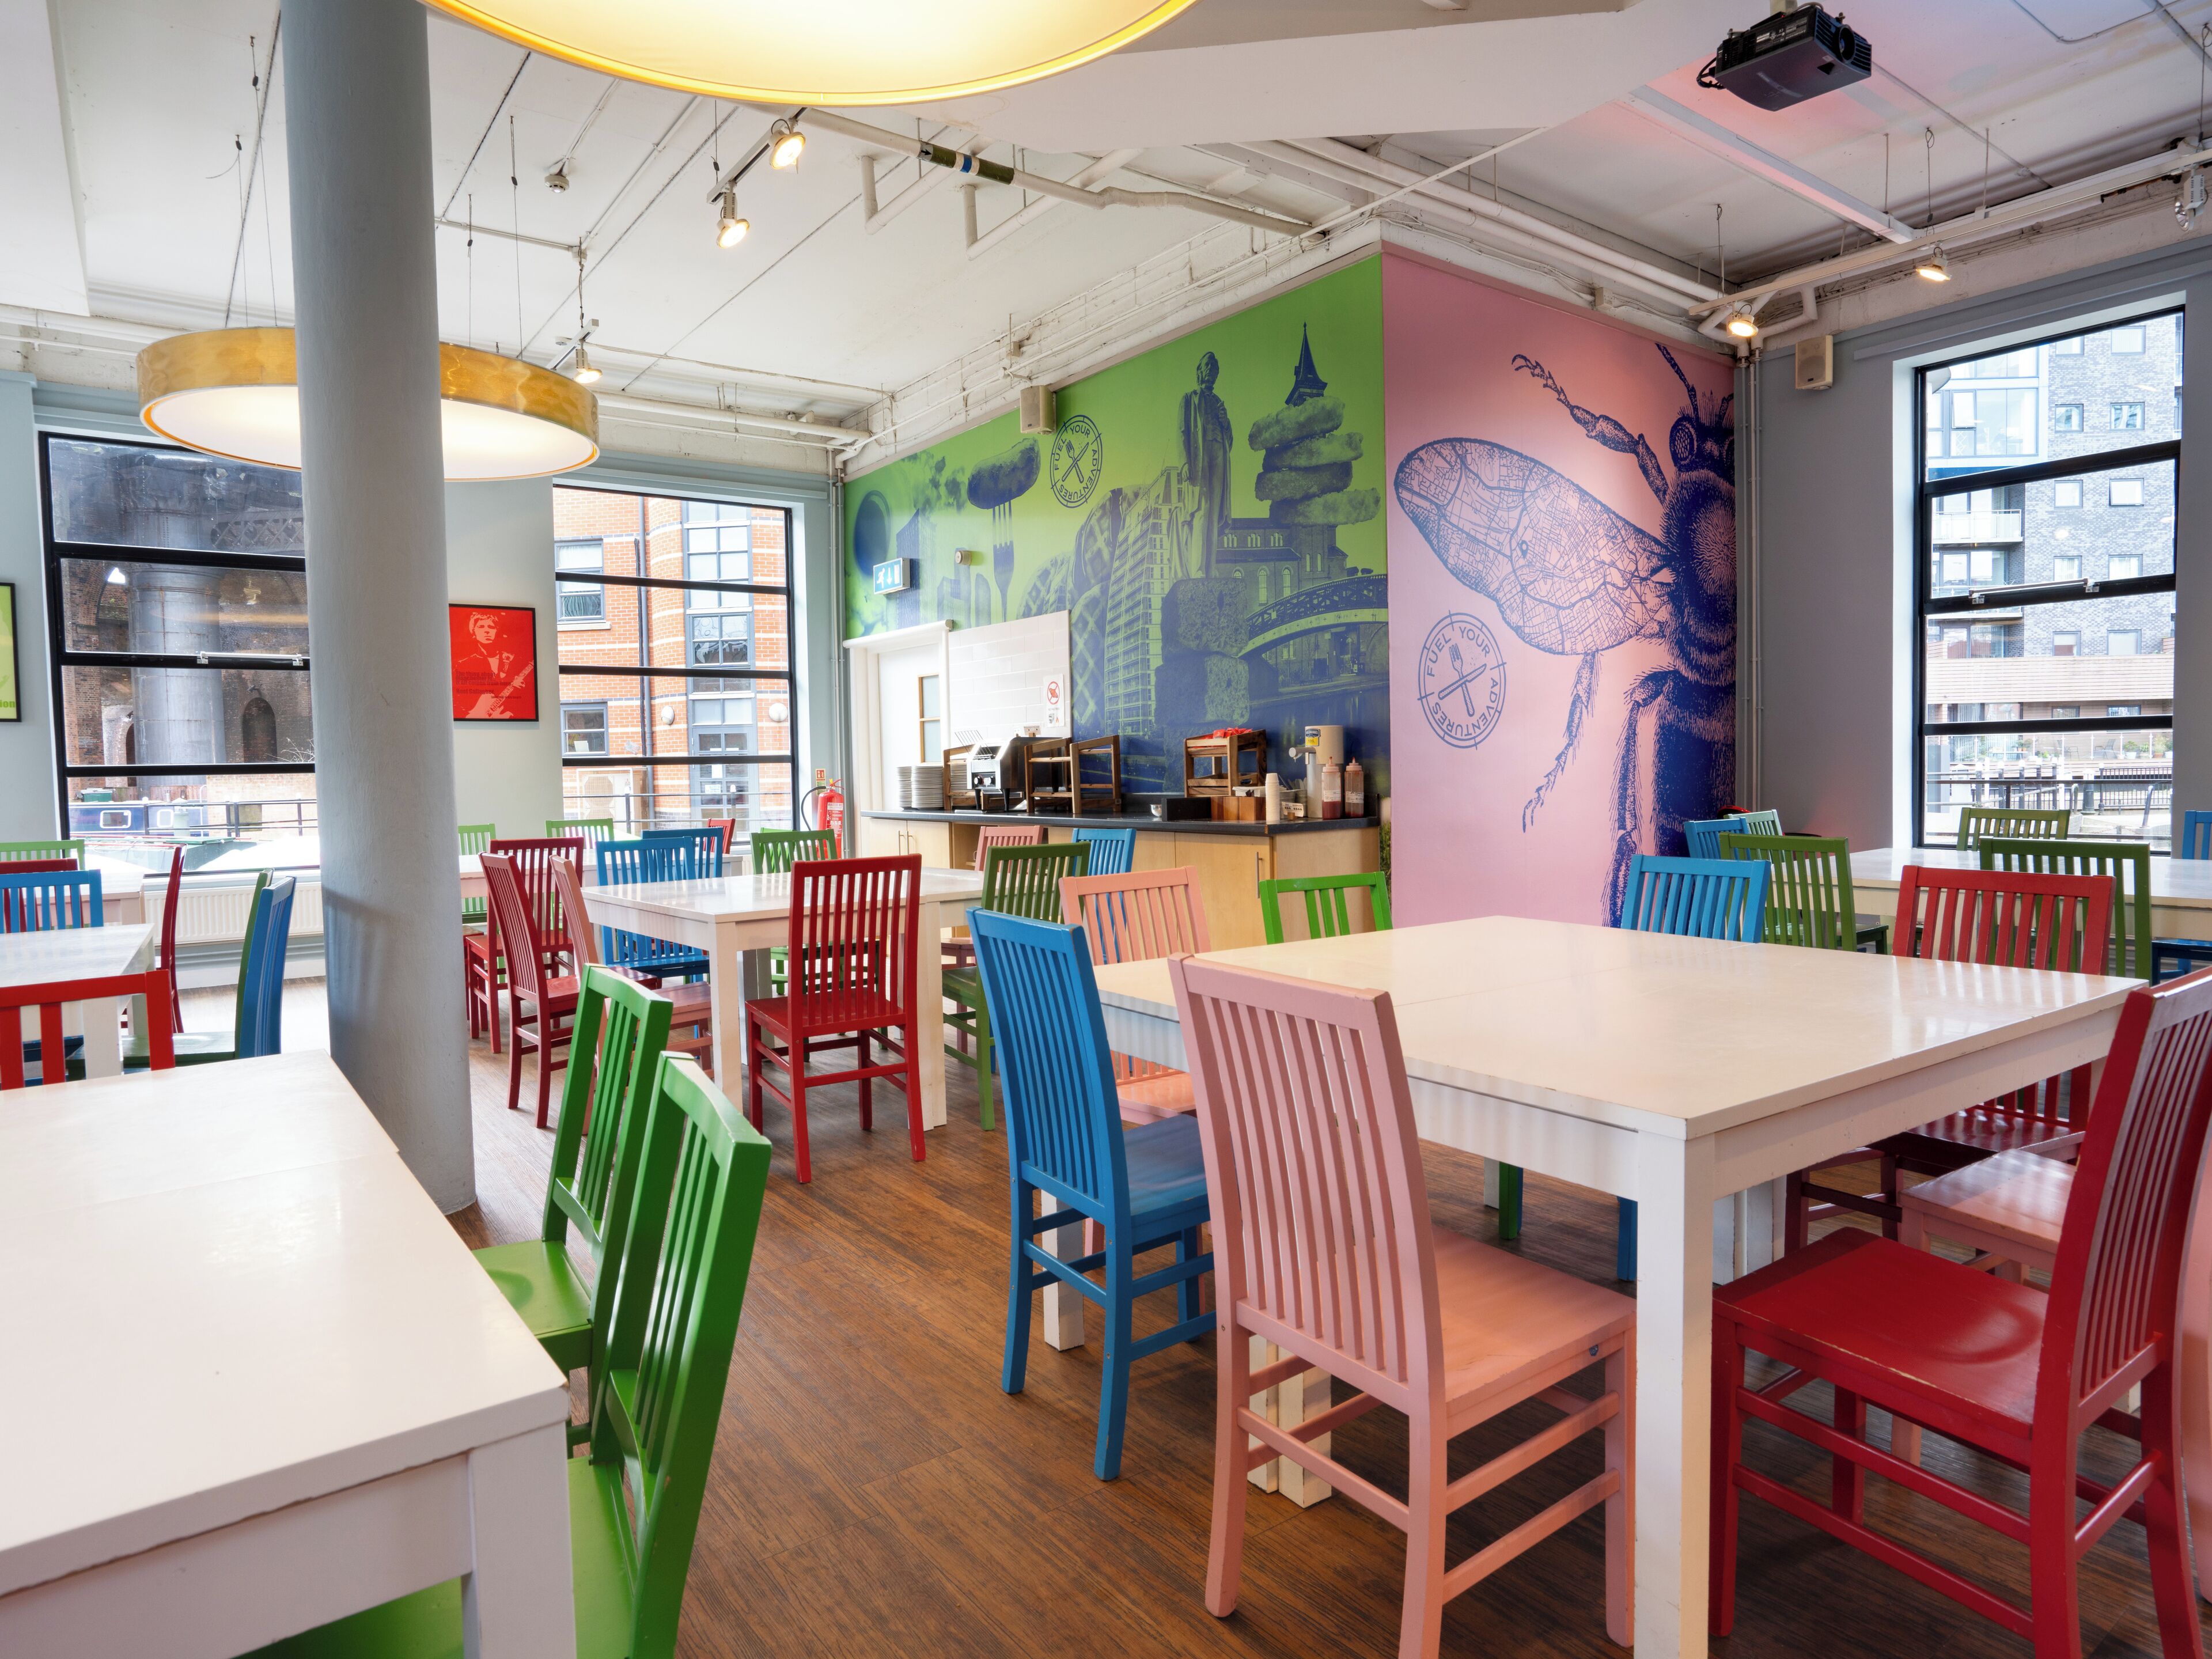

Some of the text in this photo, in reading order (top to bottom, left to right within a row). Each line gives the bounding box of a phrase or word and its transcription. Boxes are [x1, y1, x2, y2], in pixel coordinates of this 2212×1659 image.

[1054, 424, 1097, 501] FUEL YOUR ADVENTURES
[1426, 626, 1499, 737] FUEL YOUR ADVENTURES
